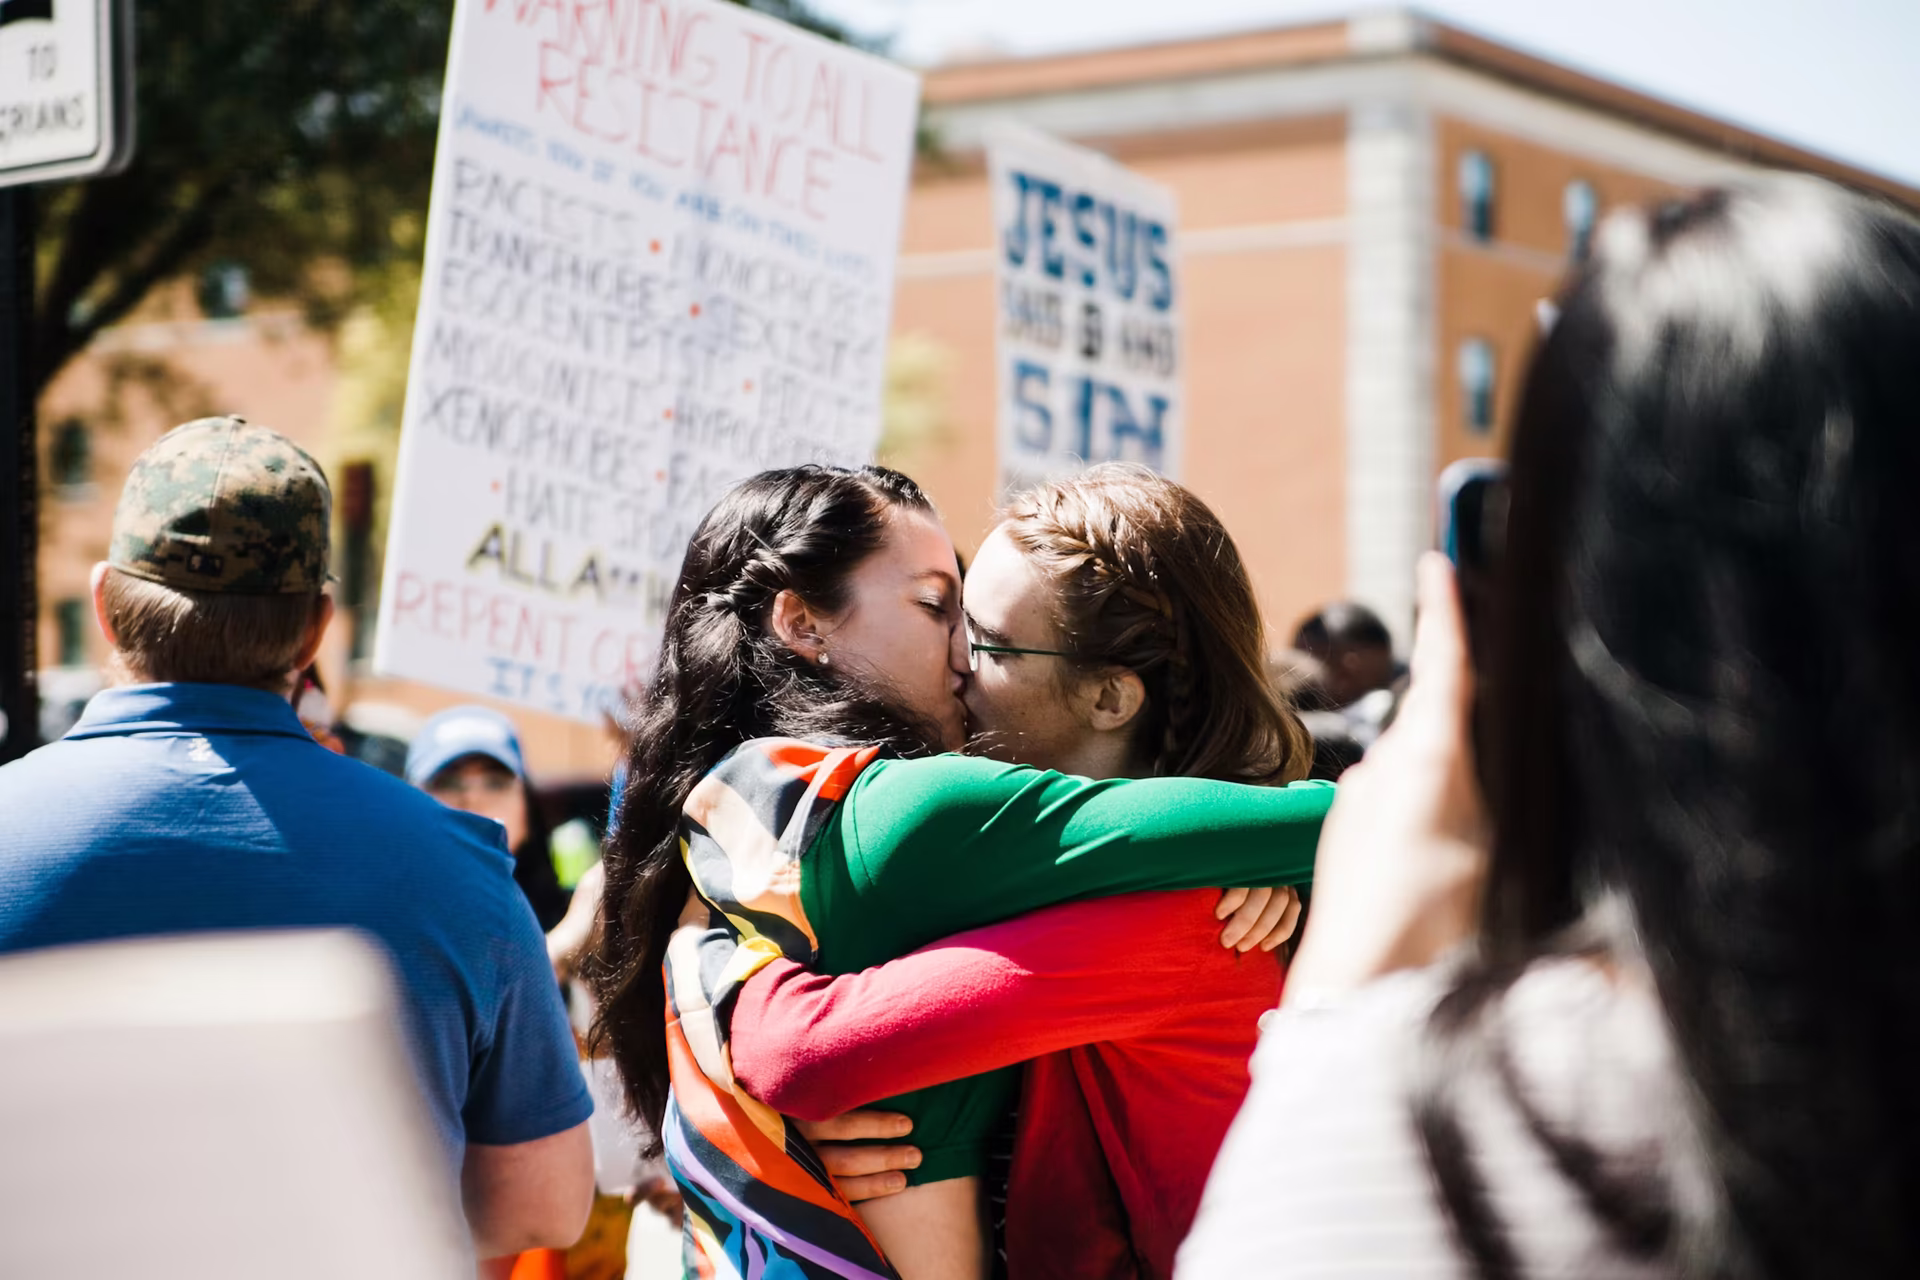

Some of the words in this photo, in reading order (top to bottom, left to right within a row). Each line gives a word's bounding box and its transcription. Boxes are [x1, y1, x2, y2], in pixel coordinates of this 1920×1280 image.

[27, 42, 59, 84] TO
[802, 61, 884, 163] ALL
[454, 156, 641, 260] RACISTS
[1004, 170, 1173, 313] JESUS
[1012, 357, 1169, 474] SIN
[504, 465, 604, 542] HATE
[391, 567, 578, 674] REPENT
